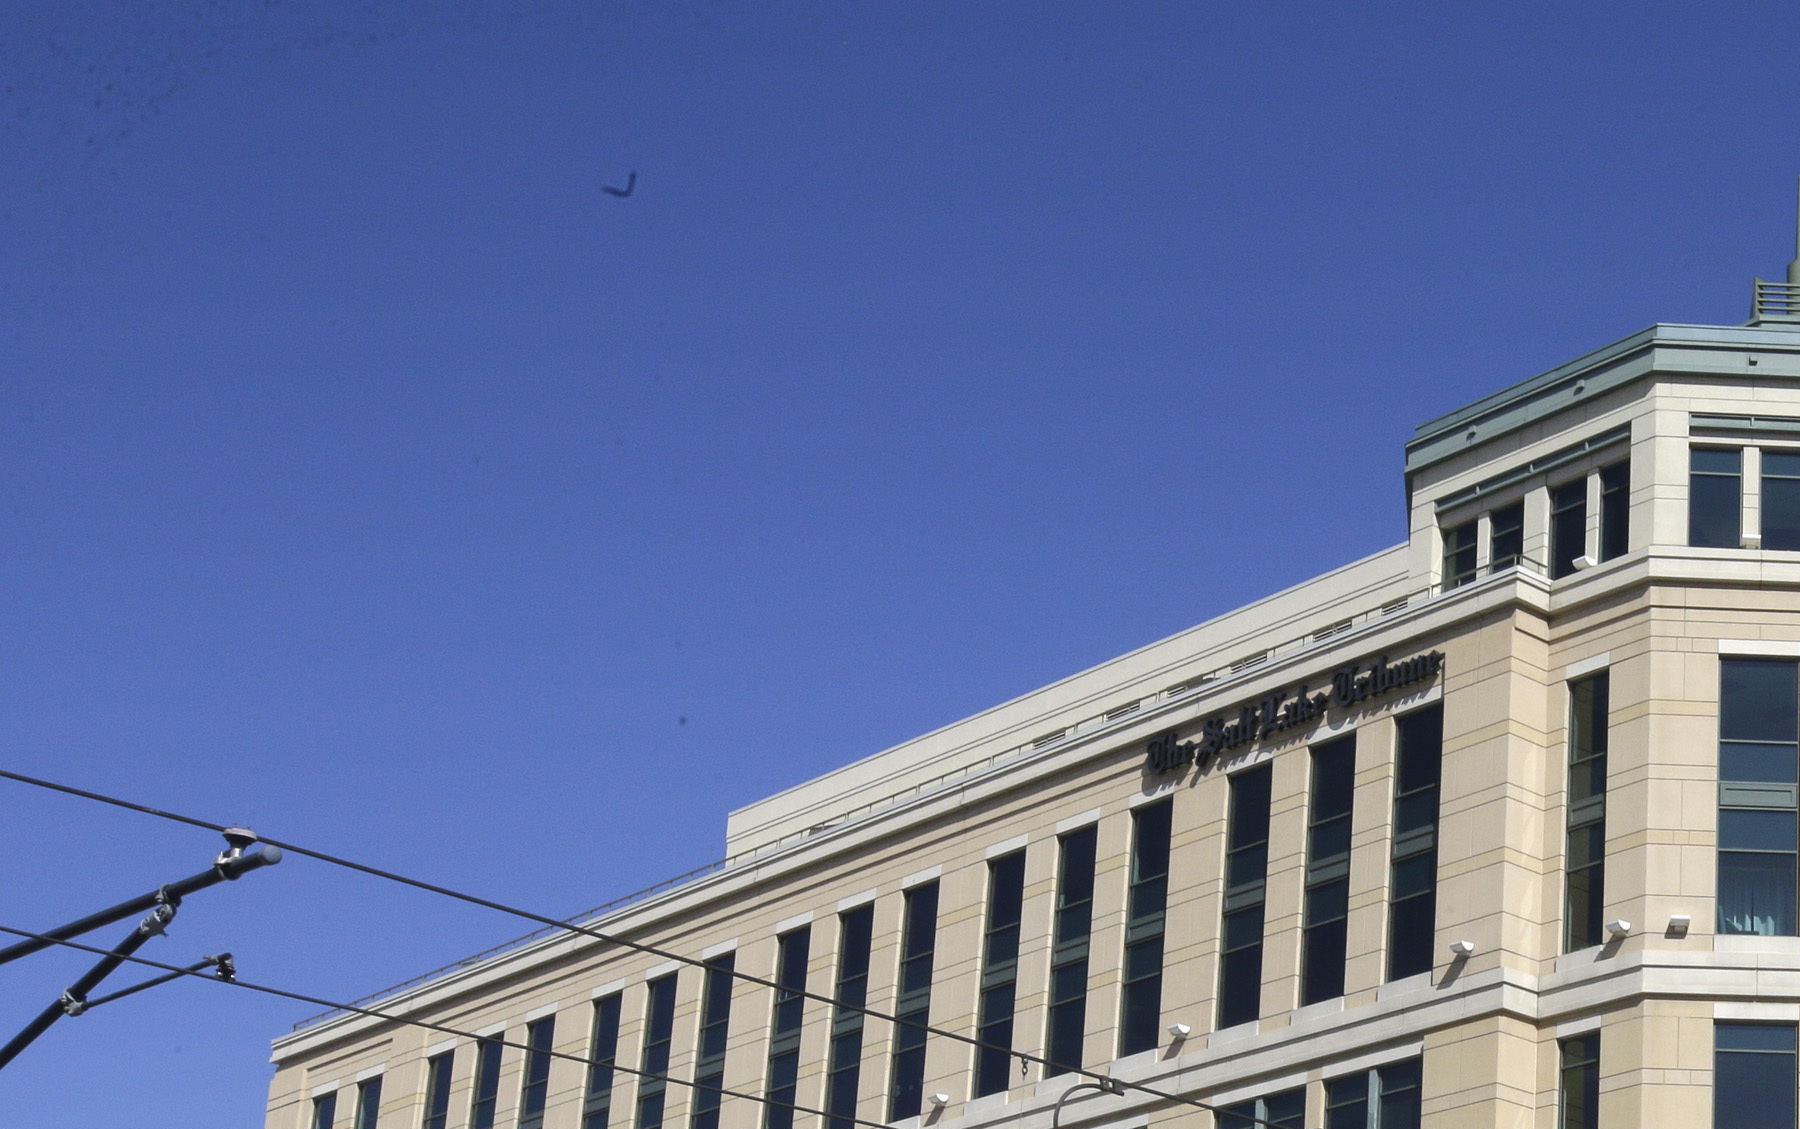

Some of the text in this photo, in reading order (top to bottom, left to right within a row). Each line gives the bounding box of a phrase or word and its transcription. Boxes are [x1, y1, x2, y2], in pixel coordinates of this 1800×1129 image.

[1146, 650, 1444, 775] The Salt Lake Tribune
